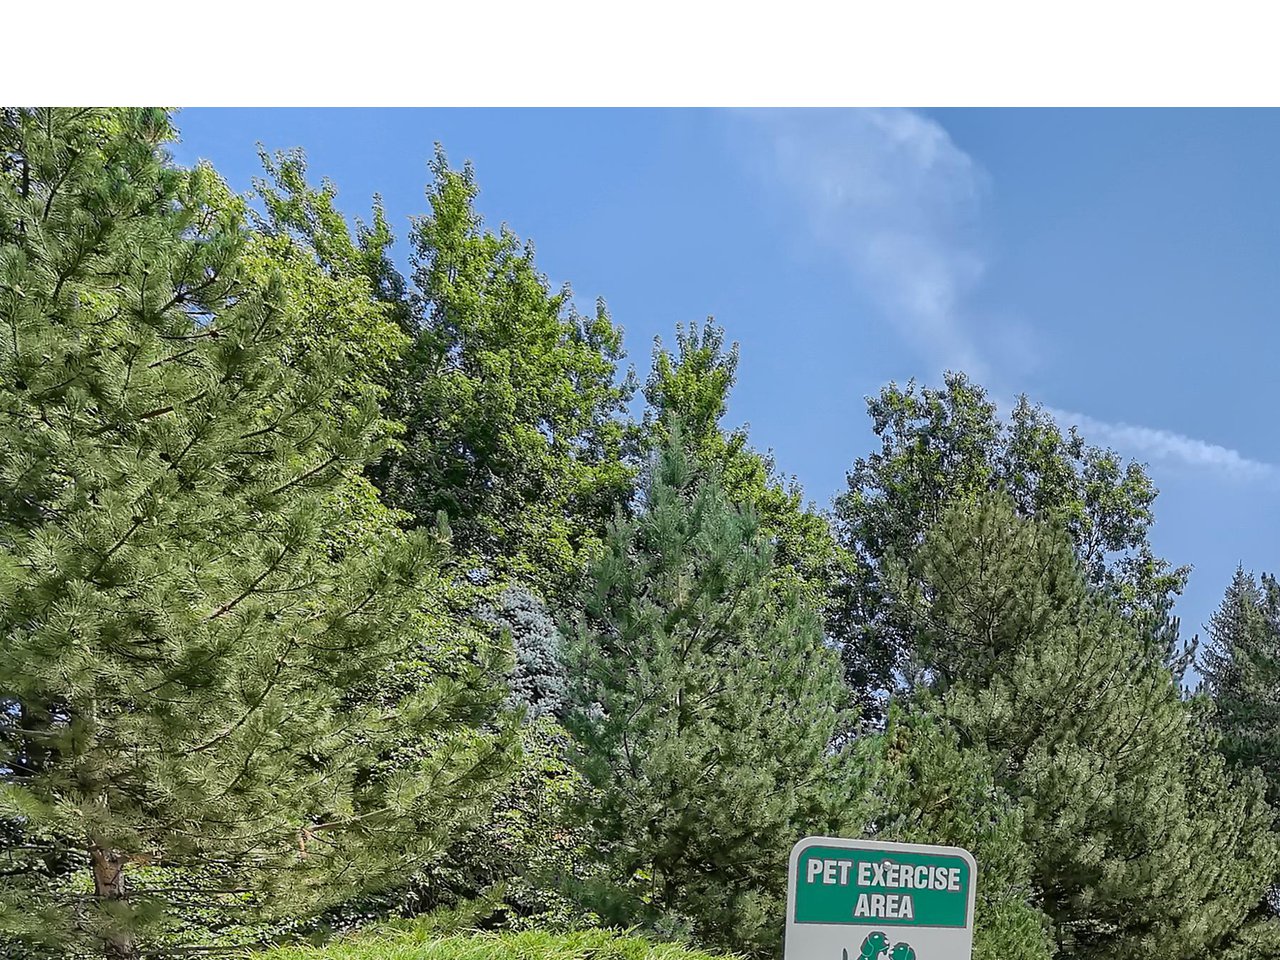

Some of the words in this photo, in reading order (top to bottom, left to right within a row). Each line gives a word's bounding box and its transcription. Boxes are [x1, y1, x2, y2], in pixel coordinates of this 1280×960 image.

[807, 859, 852, 885] PET
[857, 861, 961, 891] EXERCISE
[854, 893, 914, 919] AREA
